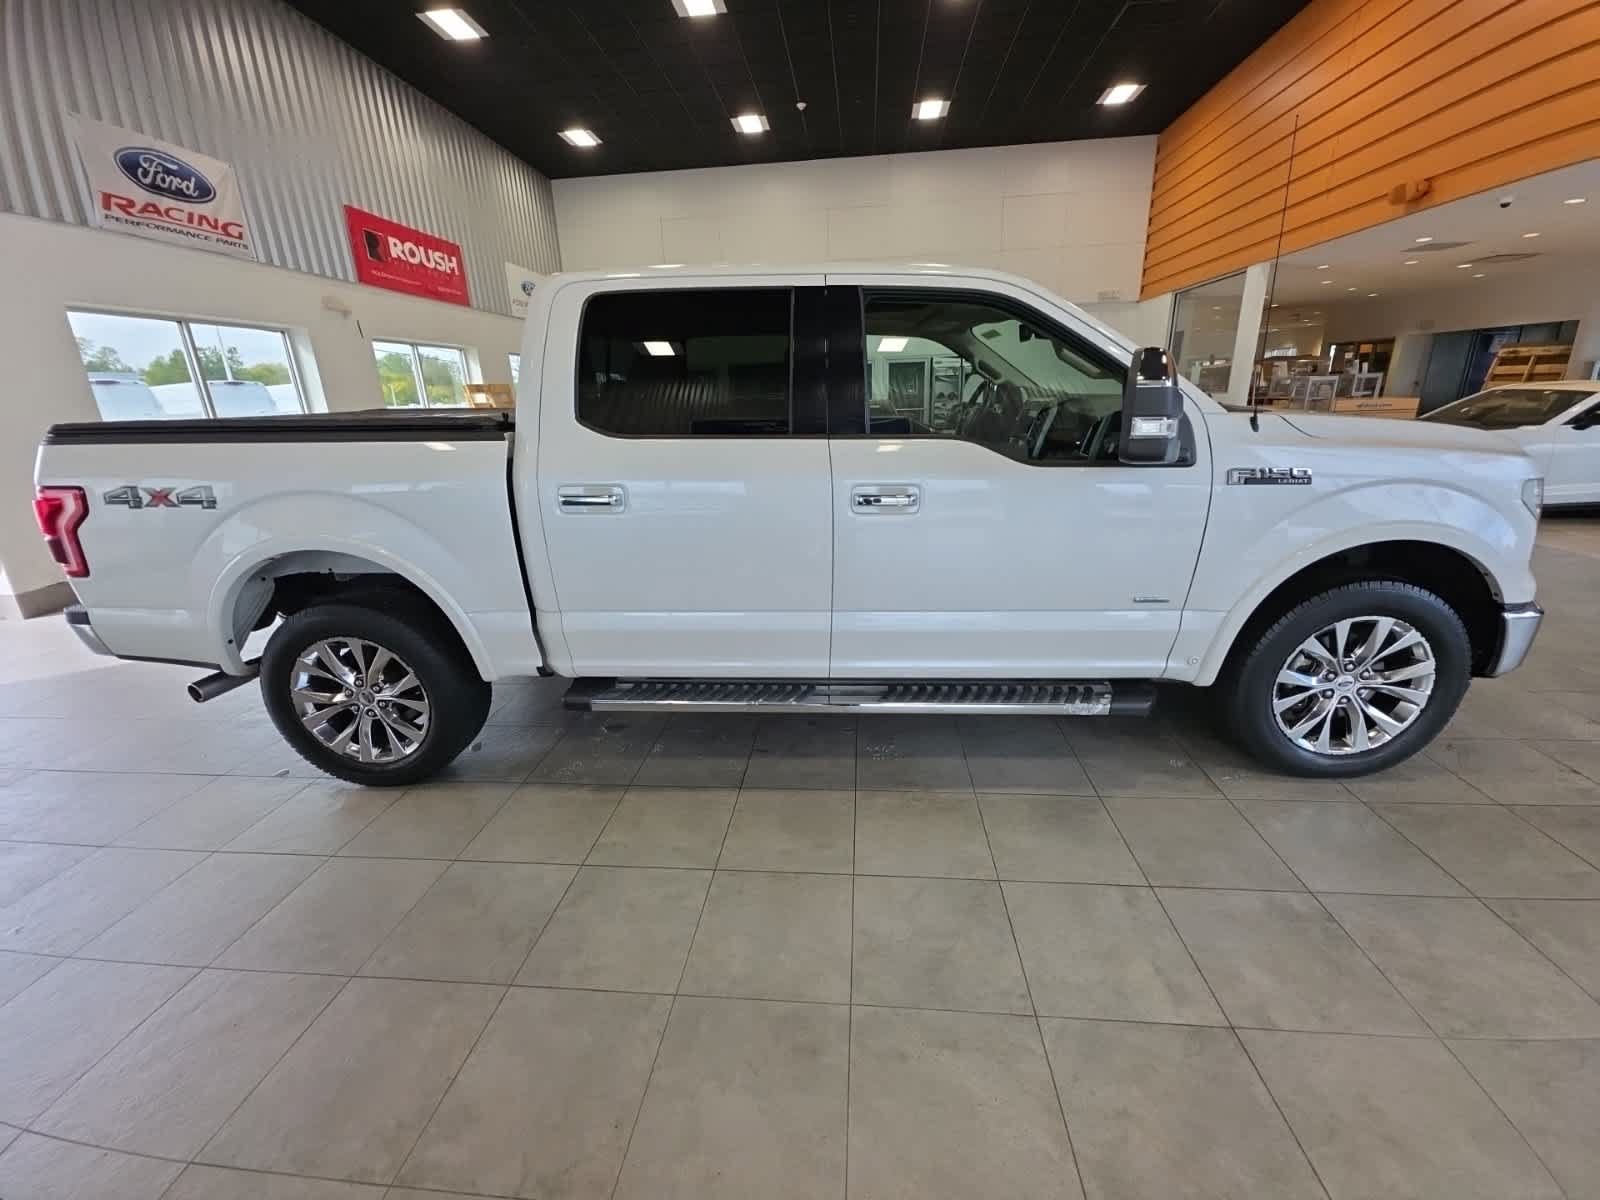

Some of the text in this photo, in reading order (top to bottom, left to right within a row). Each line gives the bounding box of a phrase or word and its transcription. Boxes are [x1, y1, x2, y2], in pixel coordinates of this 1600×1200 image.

[137, 154, 199, 197] Ford
[99, 191, 244, 240] RACING
[103, 213, 249, 250] PERFORMANCE PARTS
[387, 235, 460, 276] ROUSH
